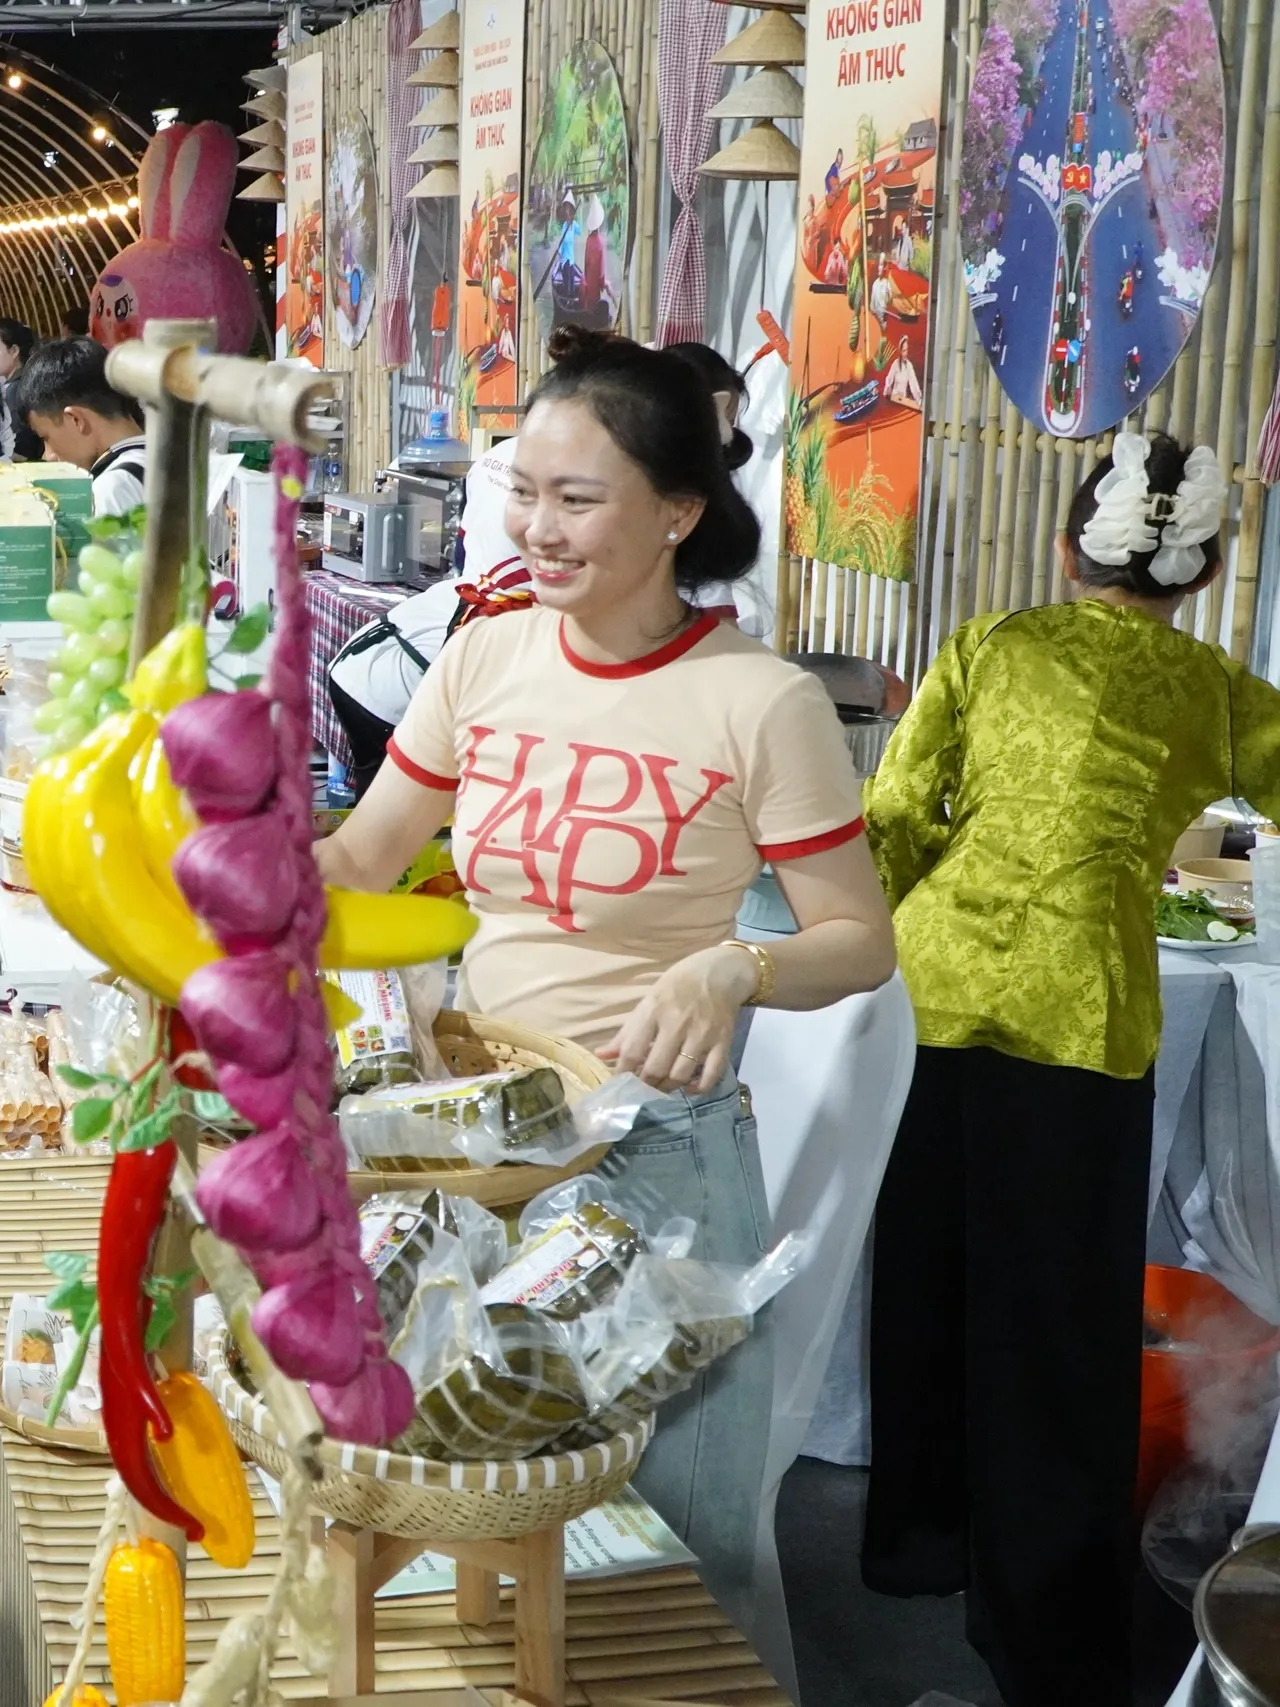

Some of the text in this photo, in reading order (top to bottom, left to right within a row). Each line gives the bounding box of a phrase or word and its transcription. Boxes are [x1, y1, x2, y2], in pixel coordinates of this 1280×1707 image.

[826, 0, 922, 41] KHÔNG GIAN
[837, 41, 906, 87] ẨM THỰC
